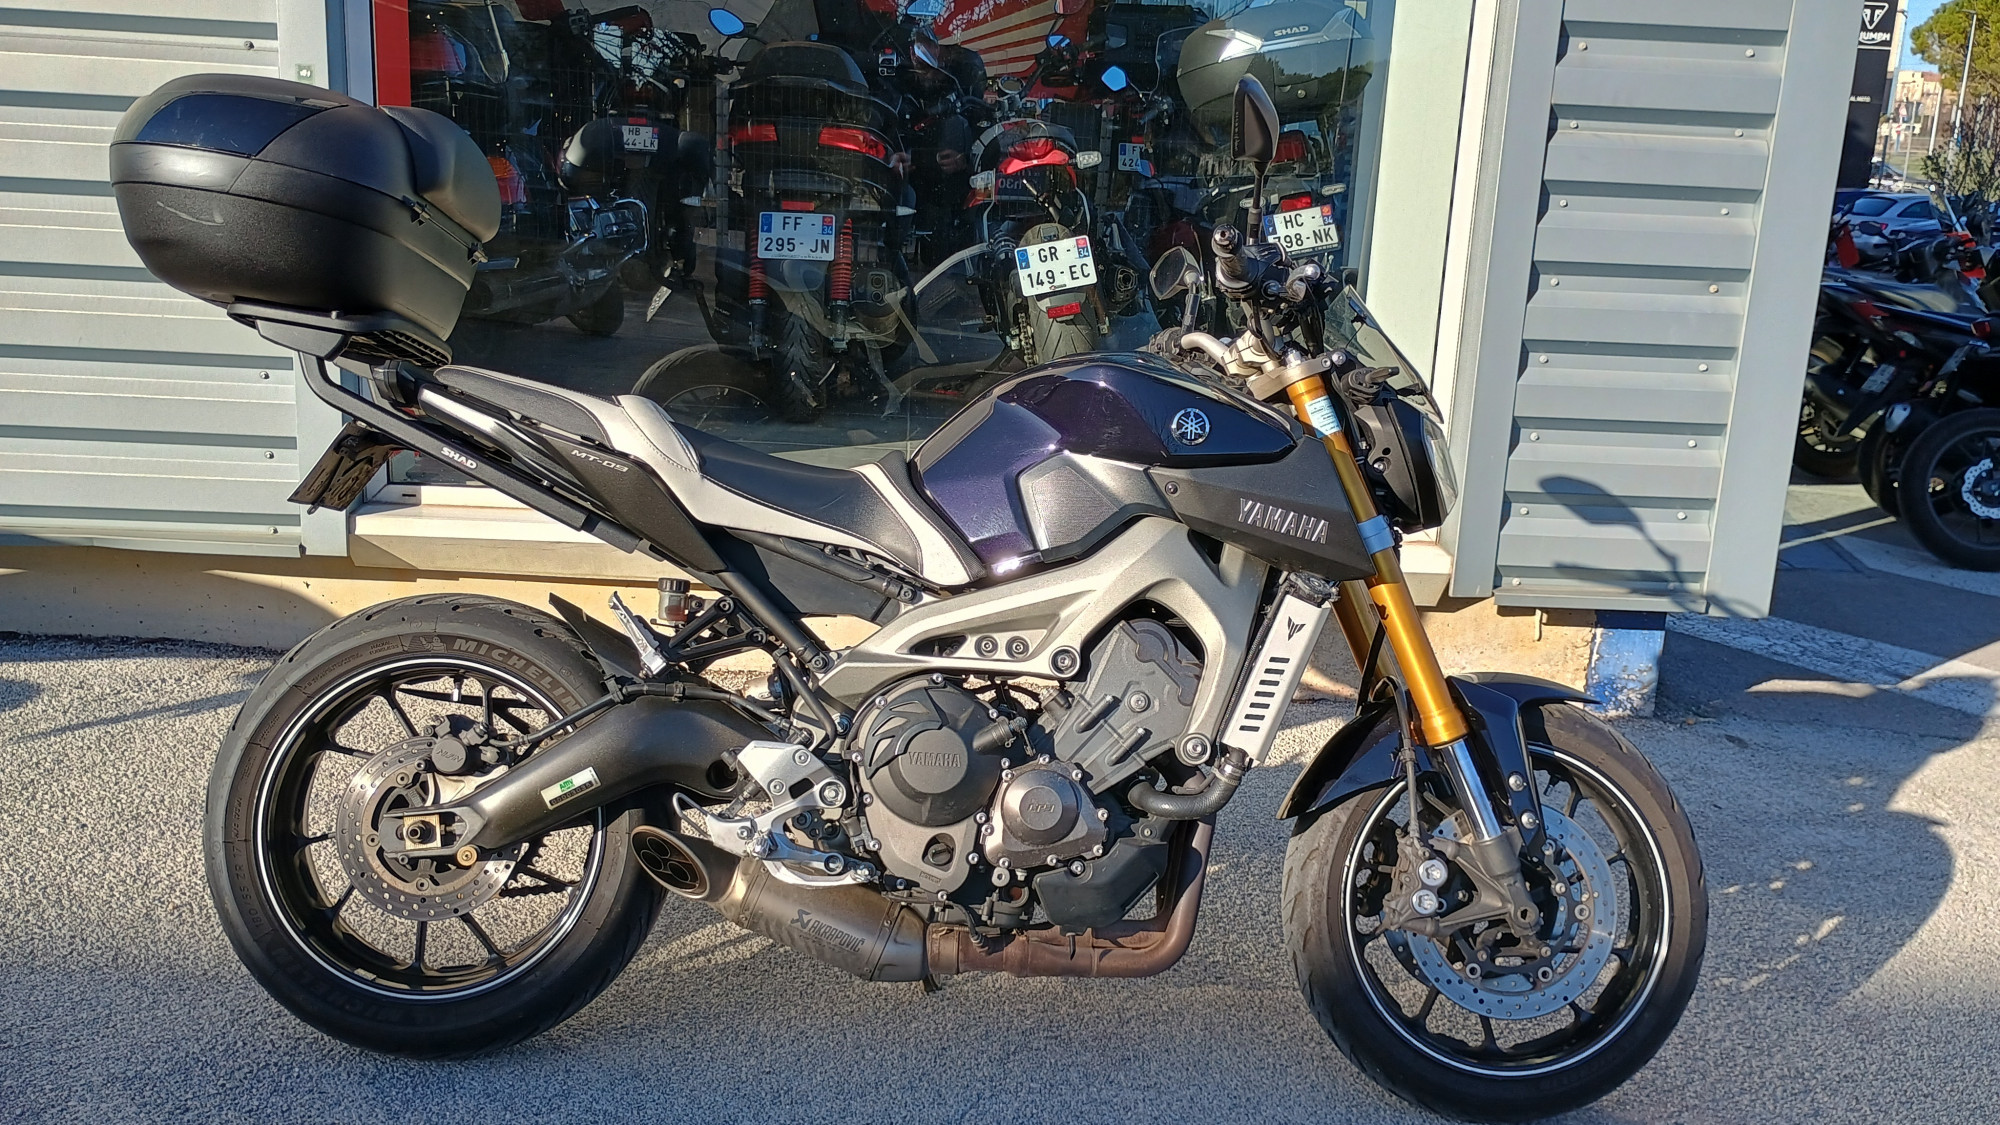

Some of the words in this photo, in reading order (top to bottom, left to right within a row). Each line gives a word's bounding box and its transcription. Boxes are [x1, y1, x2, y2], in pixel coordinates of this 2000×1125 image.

[1273, 25, 1309, 37] SHAD
[628, 127, 641, 136] HB
[782, 216, 803, 231] FF
[1283, 213, 1305, 229] HC
[1323, 215, 1333, 225] 34
[822, 225, 834, 235] 34
[1038, 246, 1059, 263] GR
[1078, 247, 1089, 258] 34
[440, 446, 477, 469] SHAD
[571, 449, 629, 473] MT-09
[1238, 498, 1330, 545] YAMAHA
[453, 637, 581, 711] MICHELIN
[908, 751, 962, 768] YAMAHA
